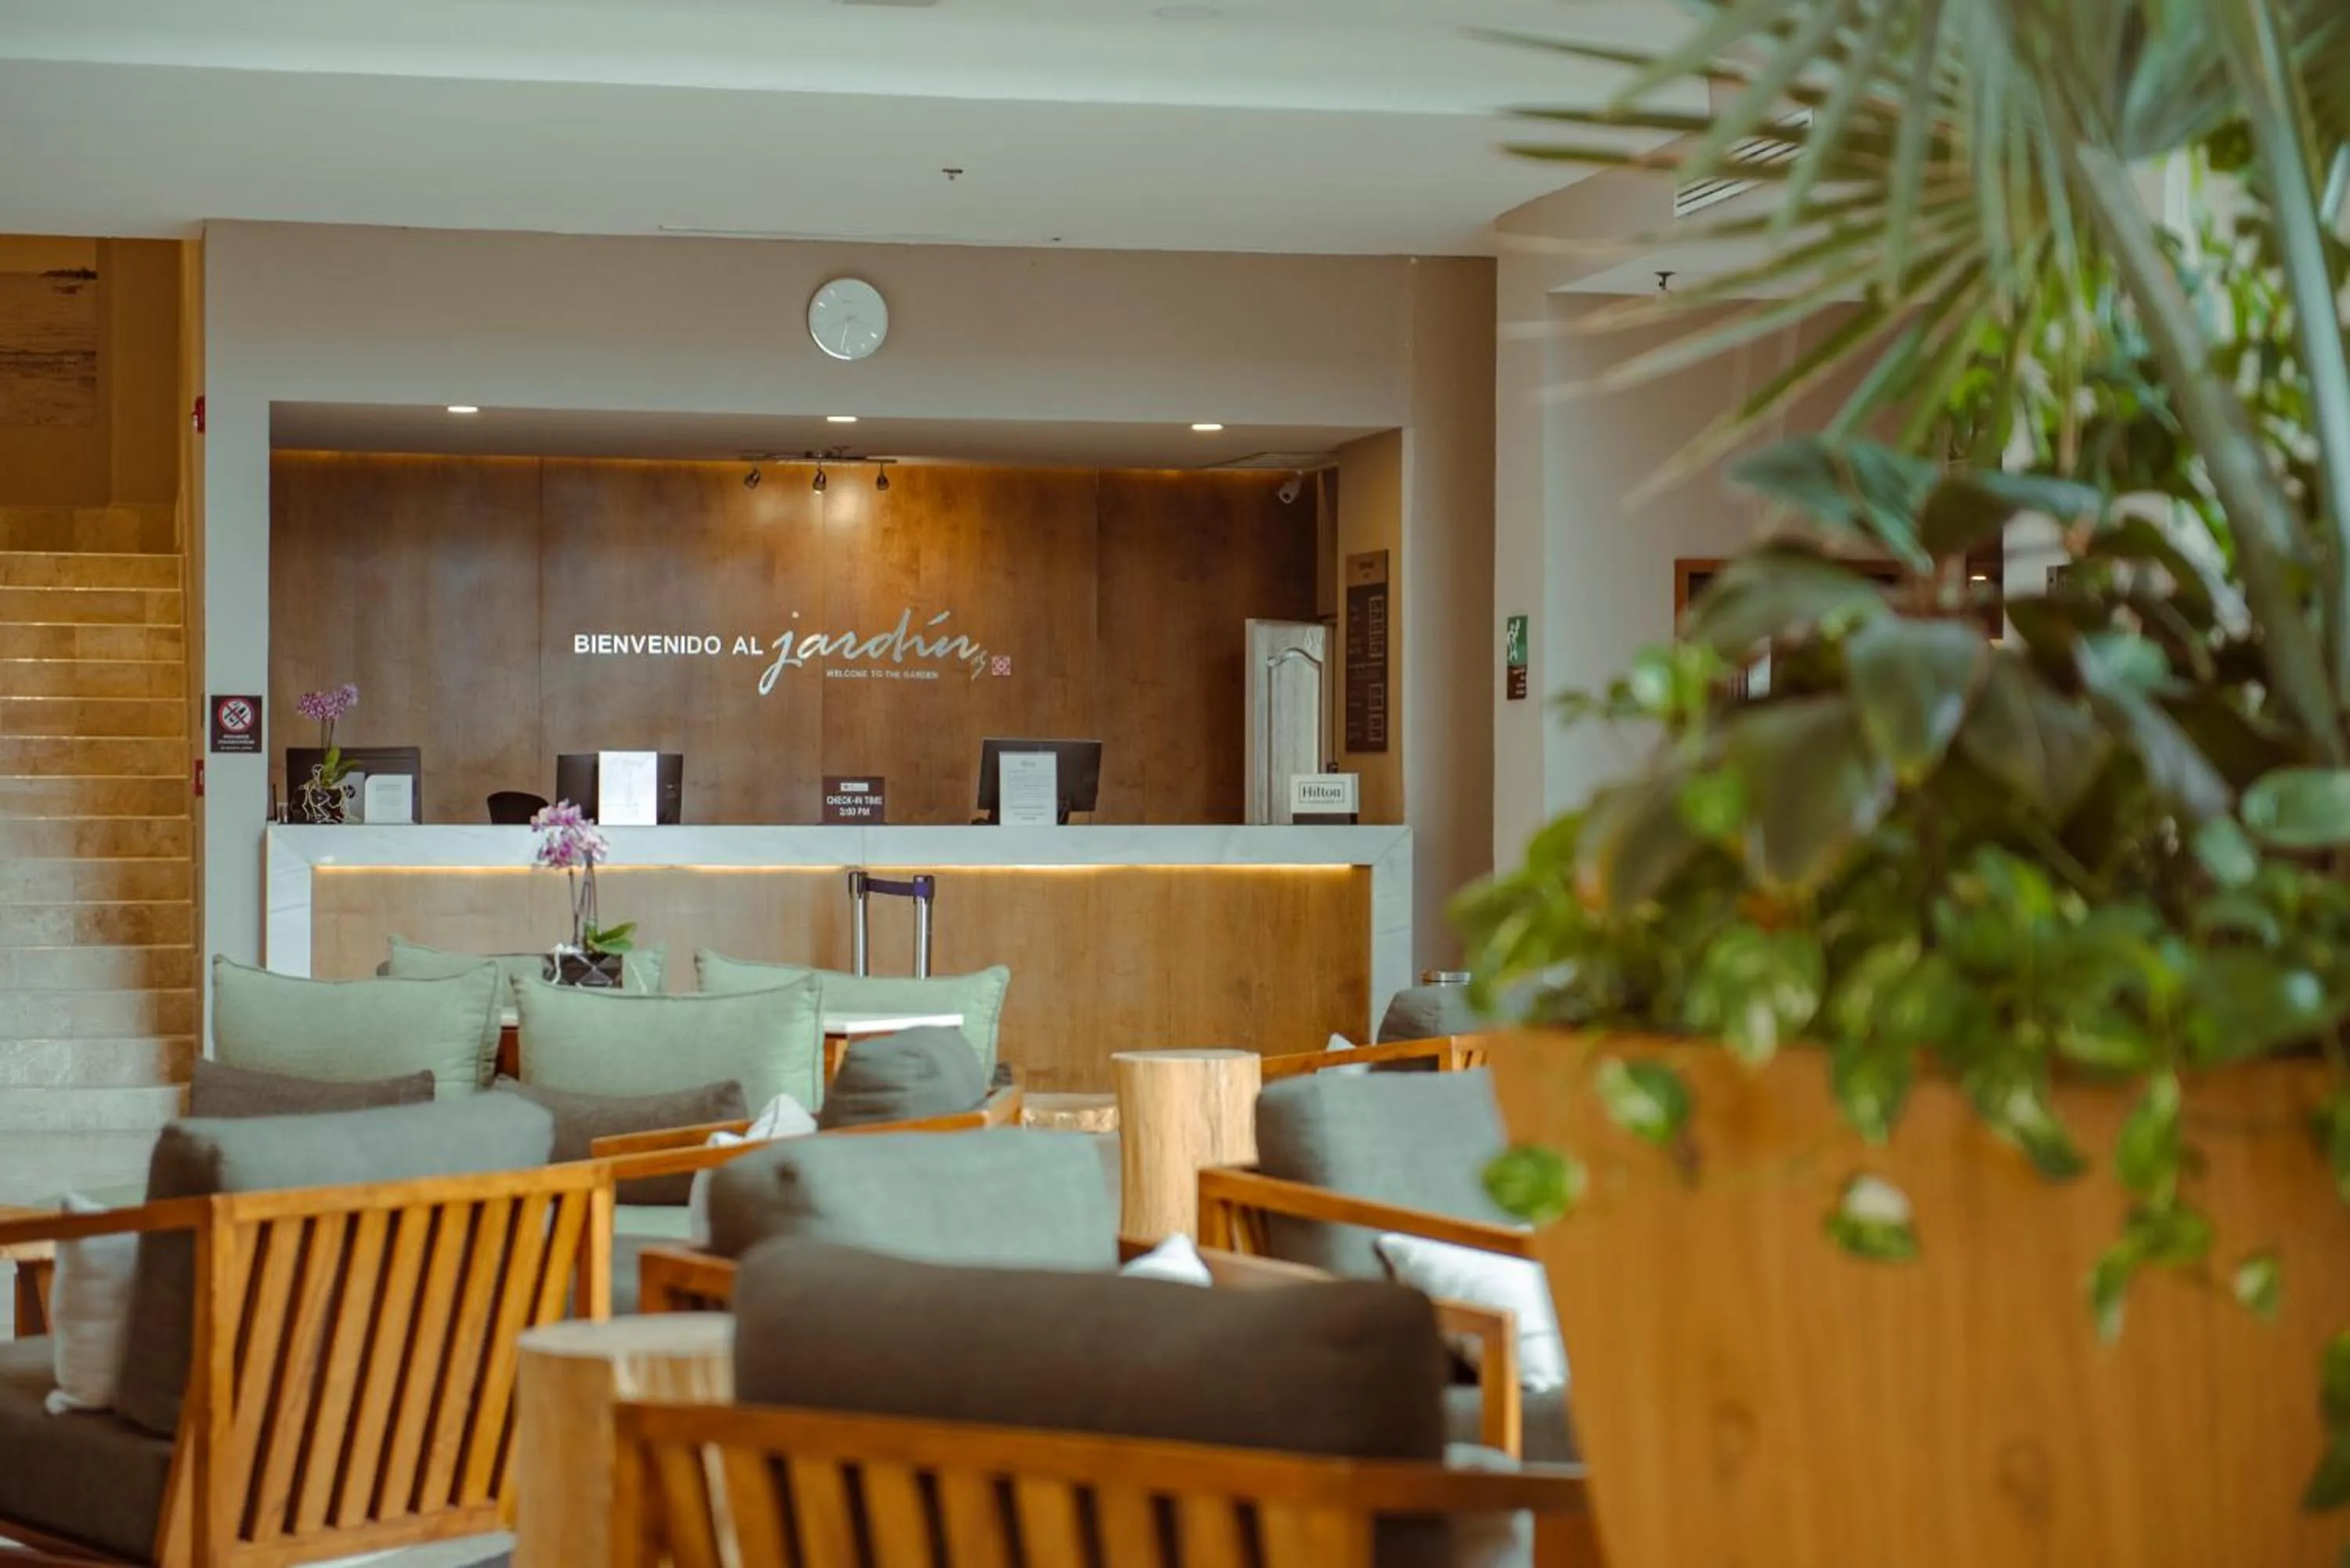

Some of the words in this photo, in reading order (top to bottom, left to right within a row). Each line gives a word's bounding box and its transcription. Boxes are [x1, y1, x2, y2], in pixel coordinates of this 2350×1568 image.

[573, 634, 721, 655] BIENVENIDO
[732, 635, 764, 655] AL
[757, 607, 980, 695] jardín
[826, 669, 867, 678] WELCOME
[871, 670, 884, 678] TO
[885, 670, 901, 678] THE
[903, 670, 938, 679] GARDEN
[1302, 786, 1341, 798] Hilton
[826, 795, 862, 805] CHECK-IN
[864, 796, 882, 805] TIME
[839, 807, 856, 816] 3:00
[858, 807, 870, 816] PM
